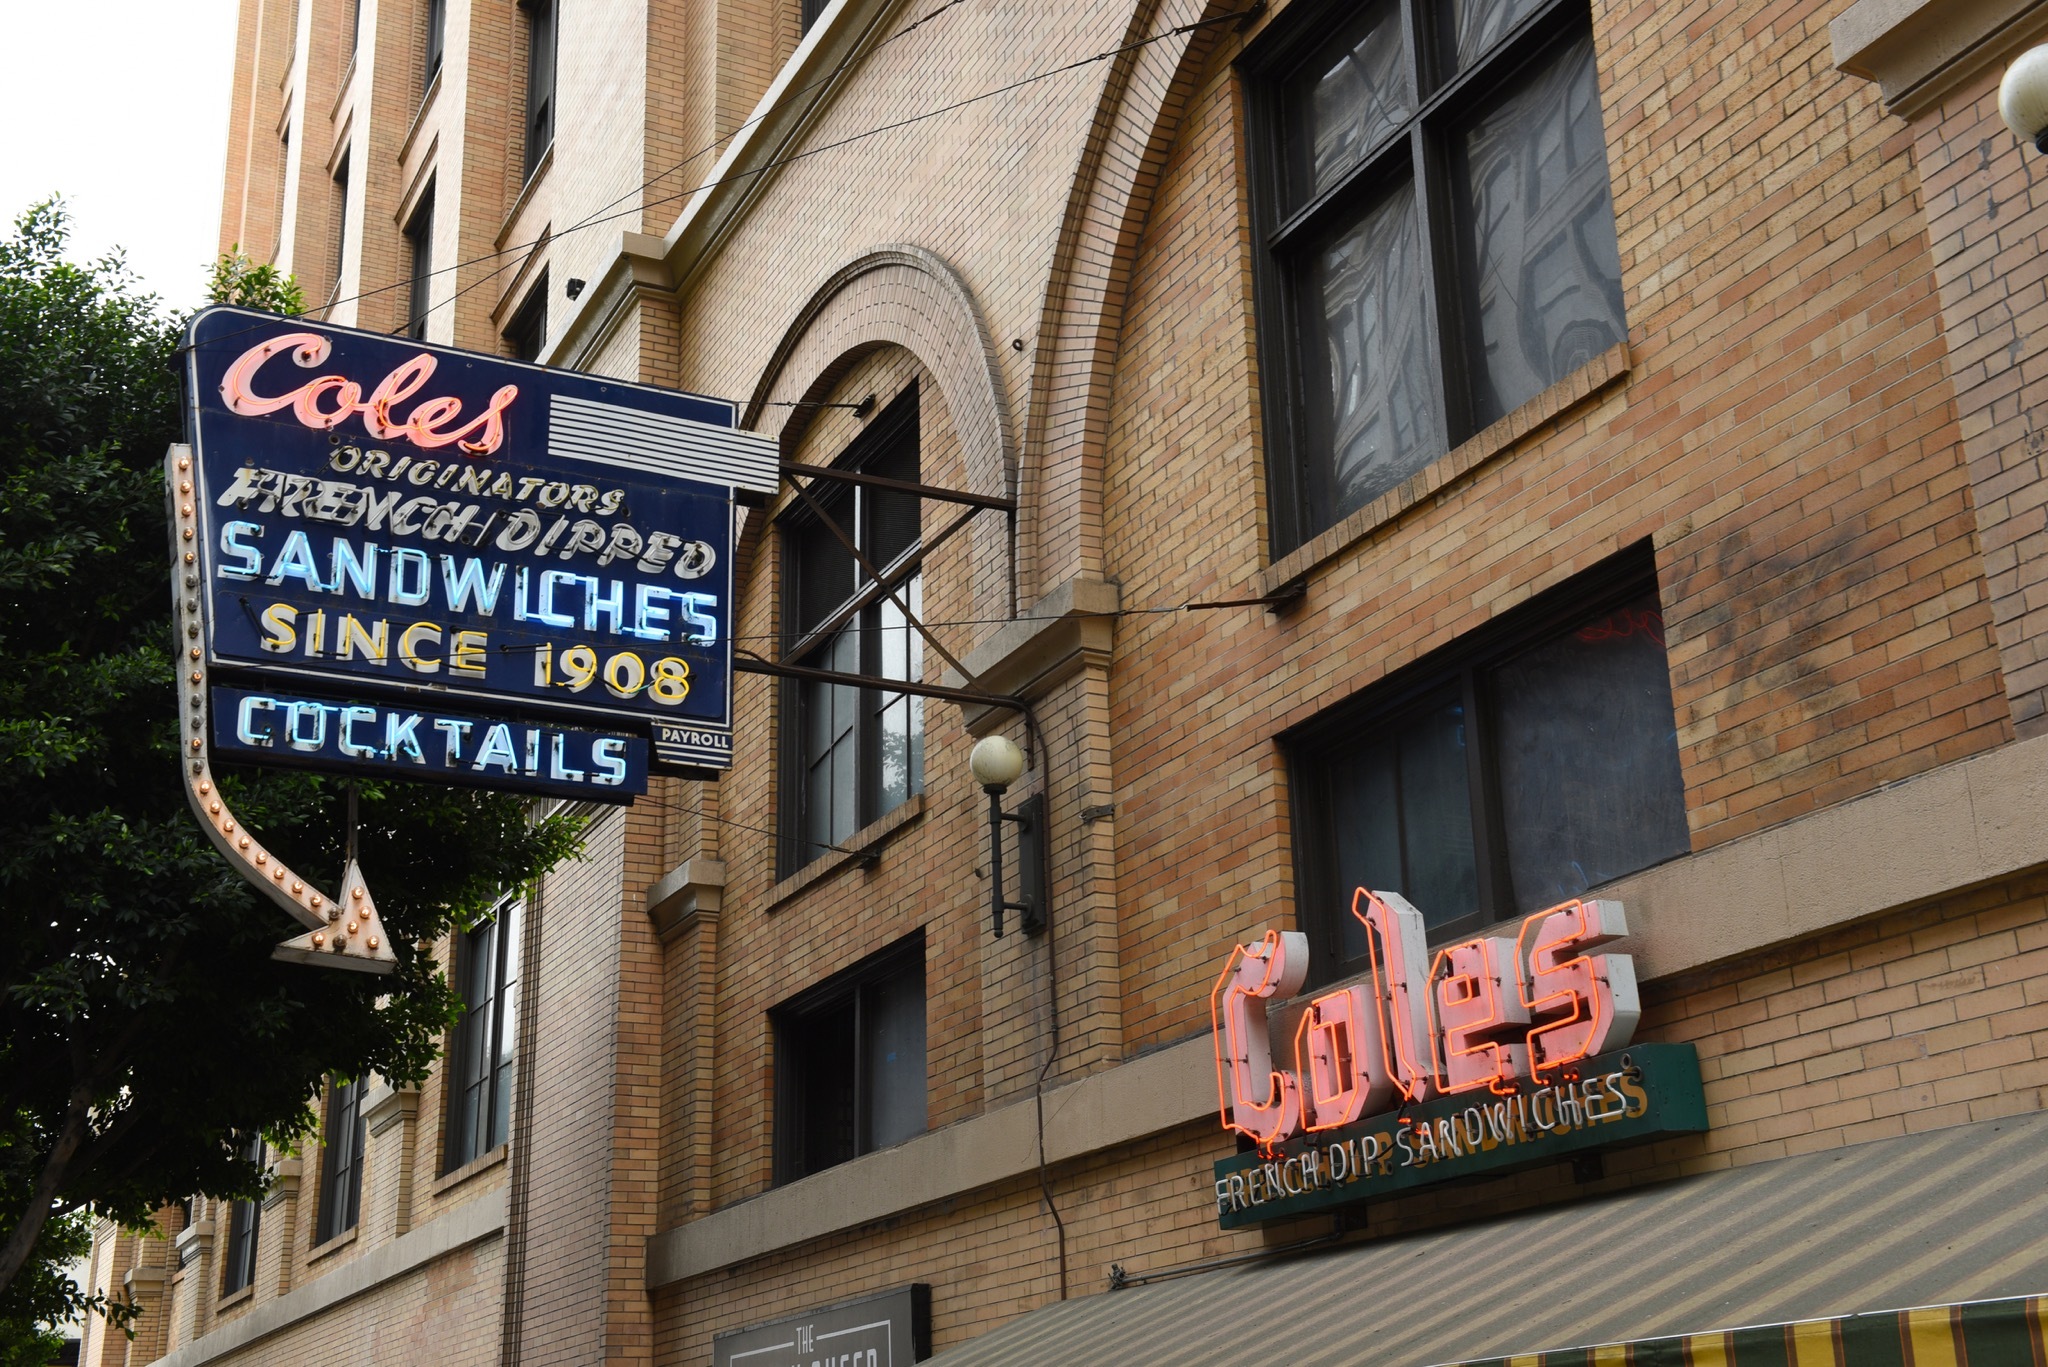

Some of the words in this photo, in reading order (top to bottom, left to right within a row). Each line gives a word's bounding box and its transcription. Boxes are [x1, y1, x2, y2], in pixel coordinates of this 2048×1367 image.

[220, 333, 518, 456] Coles
[217, 467, 490, 544] FRENCH
[496, 508, 716, 579] DIPPED
[329, 445, 625, 515] ORIGINATORS
[217, 520, 717, 647] SANDWICHES
[261, 603, 488, 679] SINCE
[535, 642, 689, 705] 1908
[237, 696, 627, 786] COCKTAILS
[662, 728, 729, 748] PAYROLL
[1211, 887, 1640, 1145] Coles
[1215, 1150, 1324, 1215] FRENCH
[1329, 1133, 1386, 1182] DIP
[1397, 1070, 1640, 1168] SANDWICHES
[796, 1324, 814, 1355] THE
